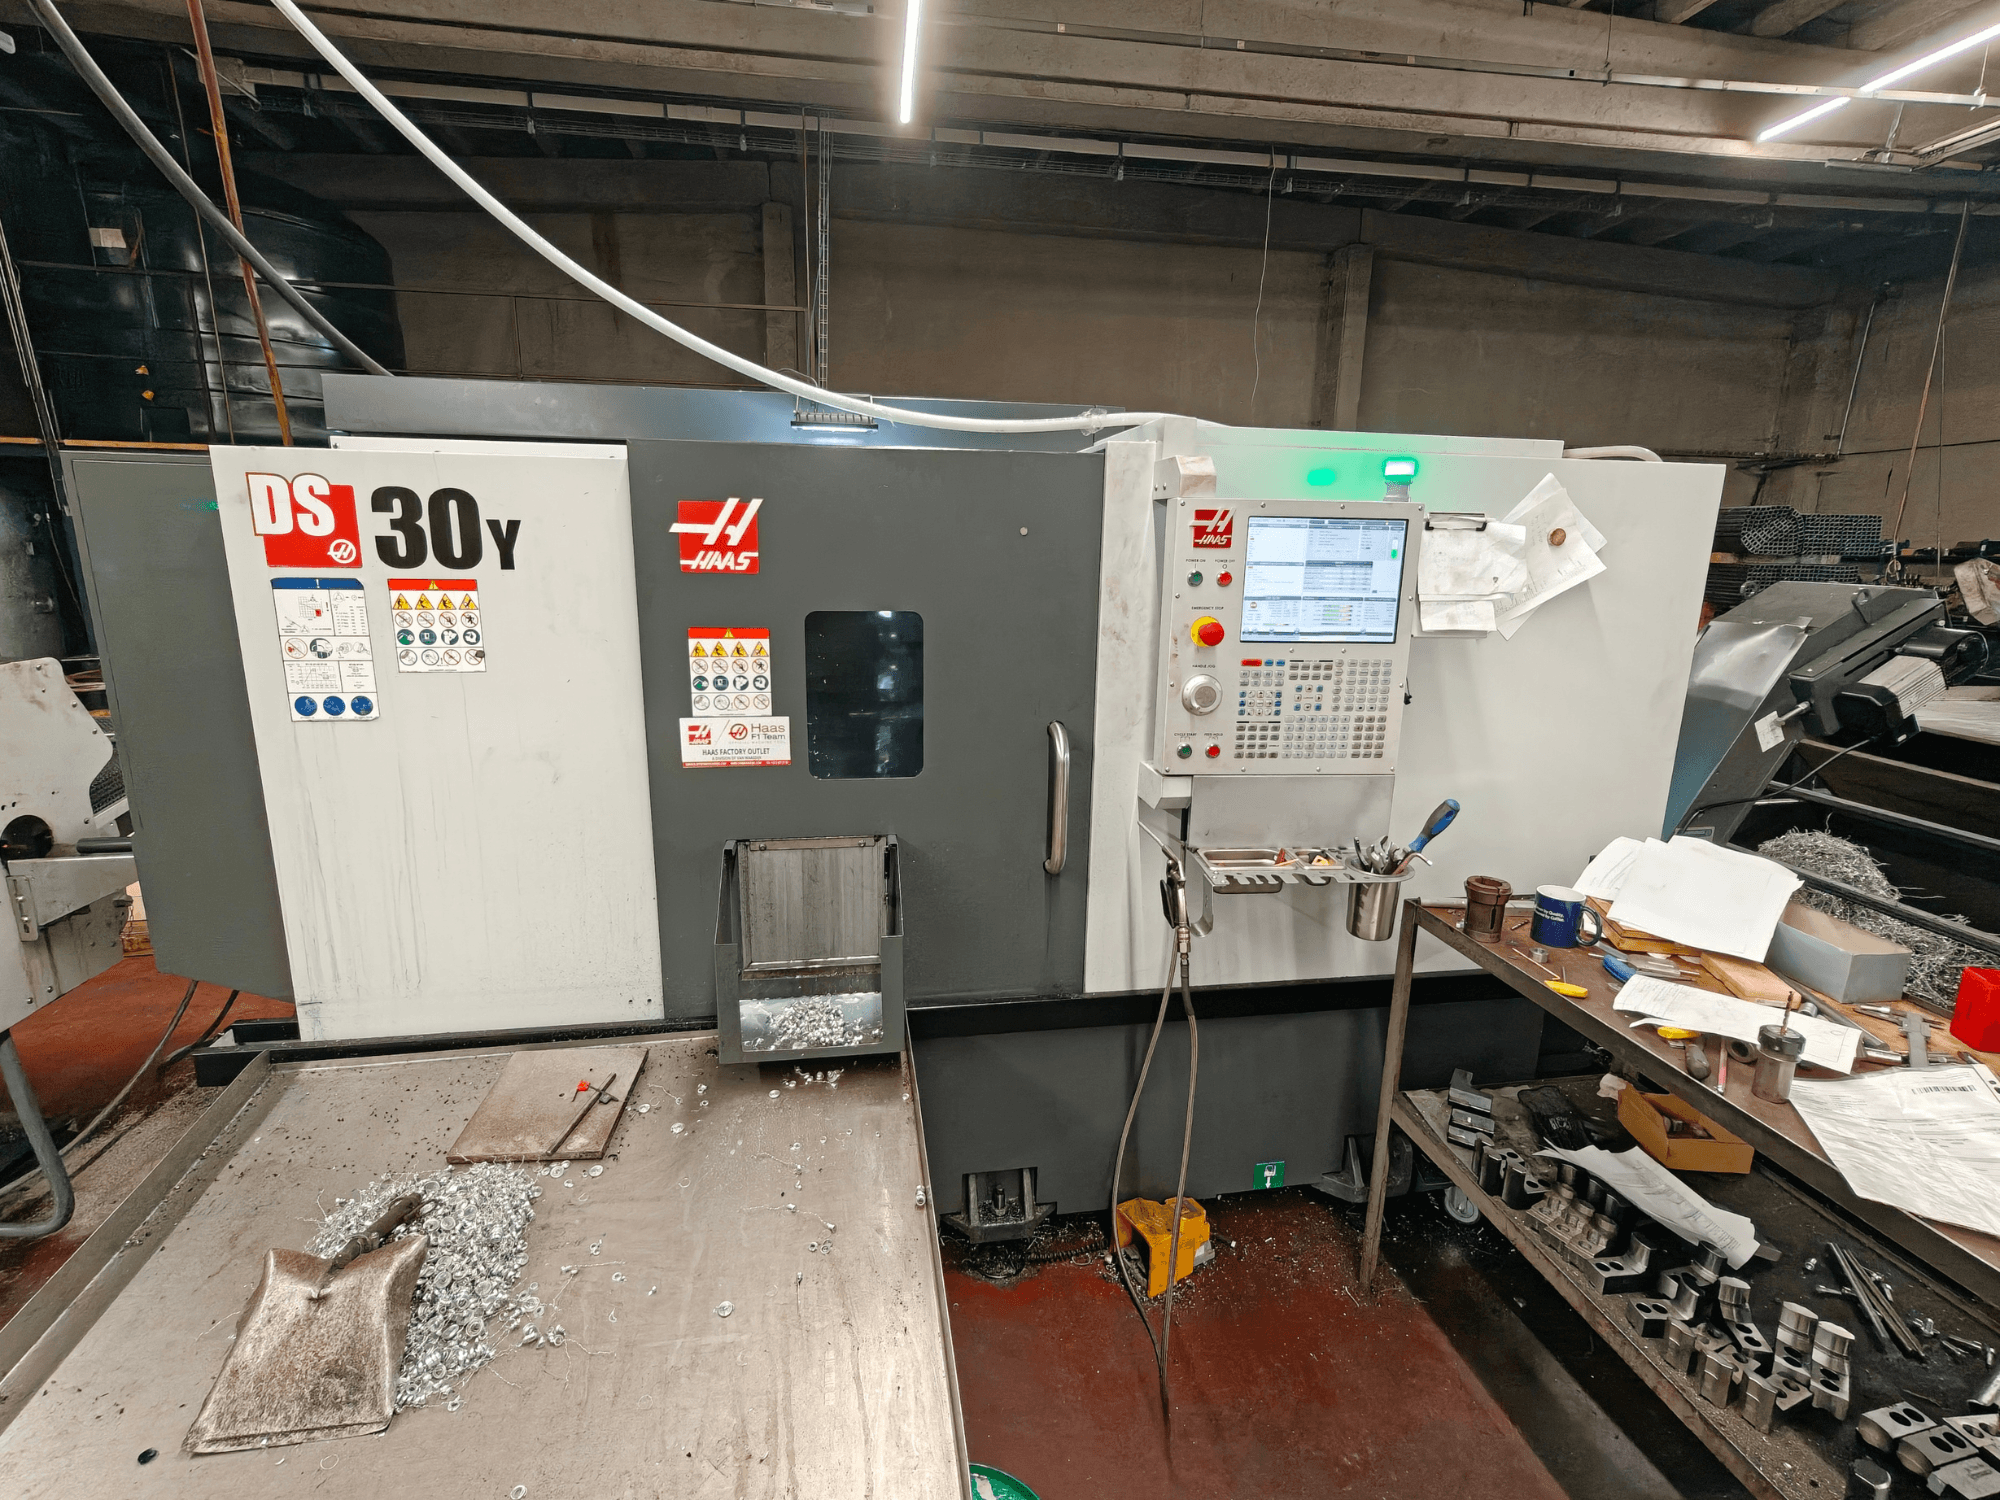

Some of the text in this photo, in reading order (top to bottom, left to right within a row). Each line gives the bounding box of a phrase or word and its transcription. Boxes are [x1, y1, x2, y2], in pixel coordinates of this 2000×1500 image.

[246, 472, 335, 537] DS
[1194, 534, 1232, 545] HAAS
[680, 550, 759, 571] HAAS
[751, 723, 786, 733] Haas
[720, 748, 746, 756] FACTORY
[748, 747, 770, 755] OUTLET
